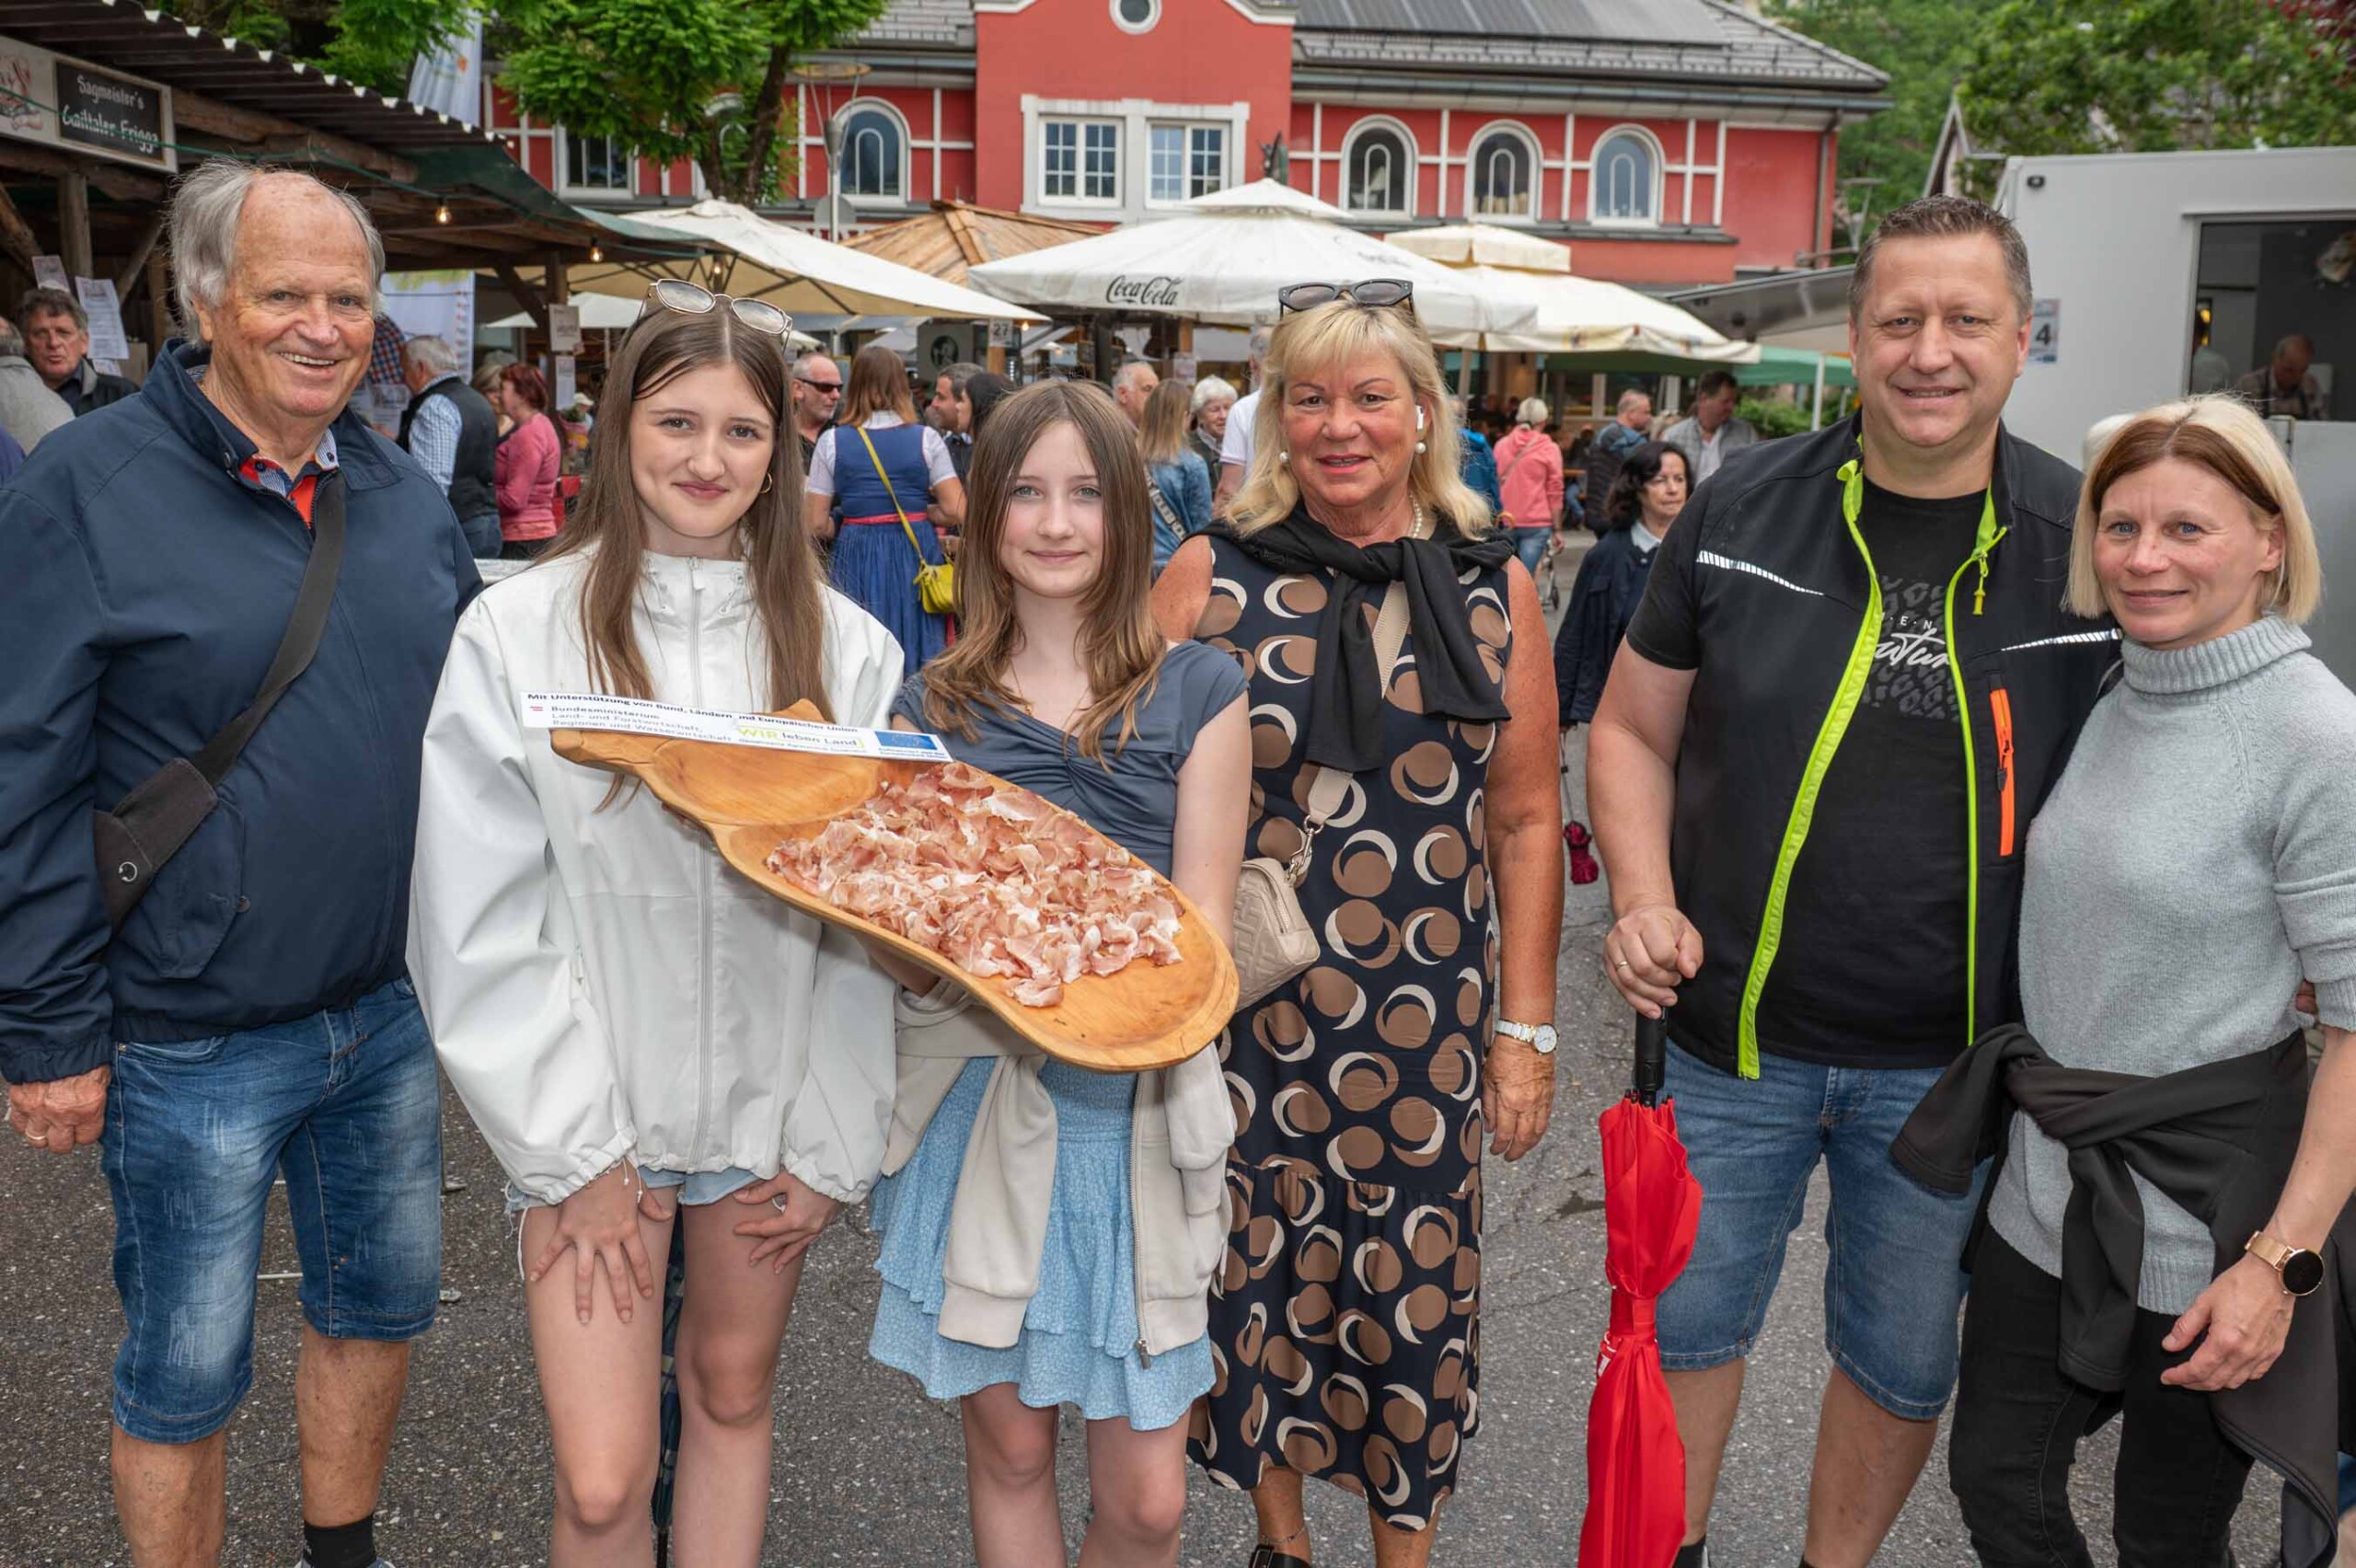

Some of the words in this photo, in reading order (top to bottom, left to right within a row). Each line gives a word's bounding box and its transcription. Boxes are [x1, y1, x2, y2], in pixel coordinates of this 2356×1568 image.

[993, 323, 1010, 337] 27
[2035, 323, 2051, 346] 4
[551, 694, 630, 706] Unterstützung
[656, 704, 687, 714] Bund,
[689, 709, 733, 719] Ländern
[757, 717, 824, 730] Europäischer
[551, 706, 660, 720] Bundesministerium
[738, 726, 778, 739] WIR
[781, 732, 821, 744] leben
[824, 738, 857, 746] Land
